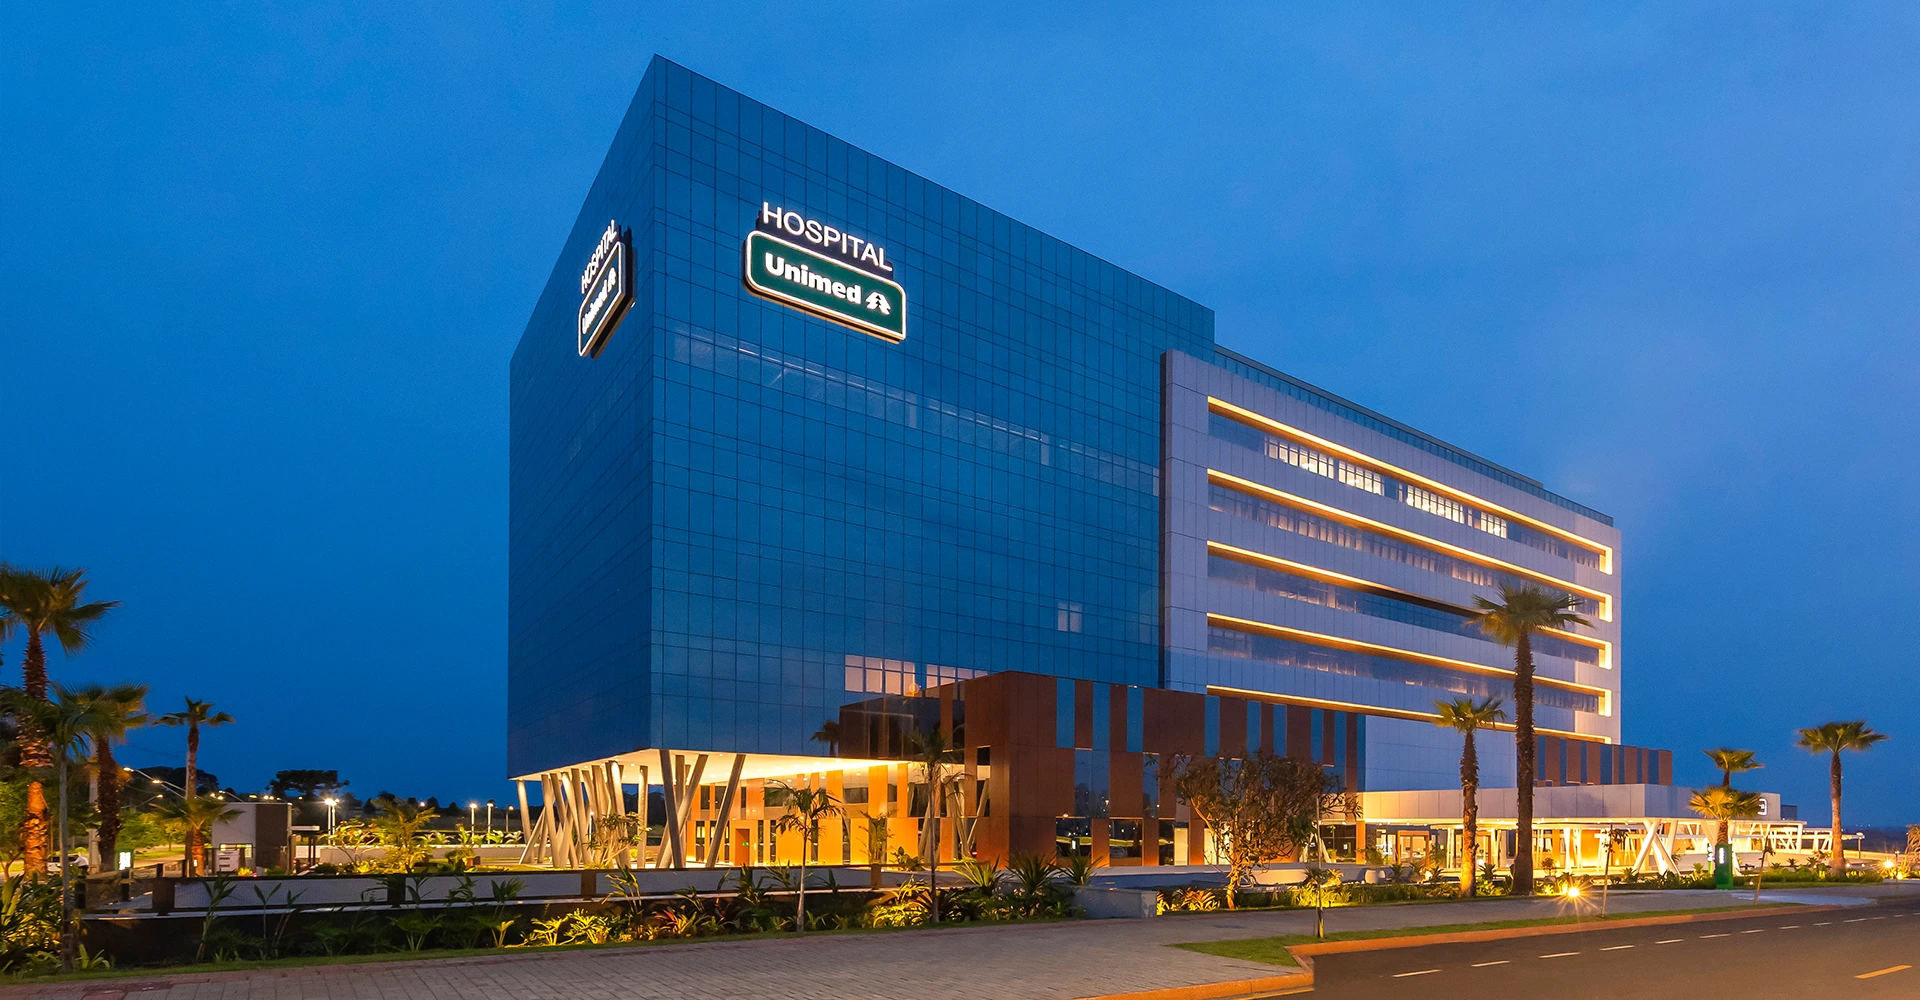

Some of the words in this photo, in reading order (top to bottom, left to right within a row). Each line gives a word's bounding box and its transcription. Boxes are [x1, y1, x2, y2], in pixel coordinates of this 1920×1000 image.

[581, 219, 617, 294] HOSPITAL
[762, 201, 893, 272] HOSPITAL
[764, 252, 862, 305] Unimed
